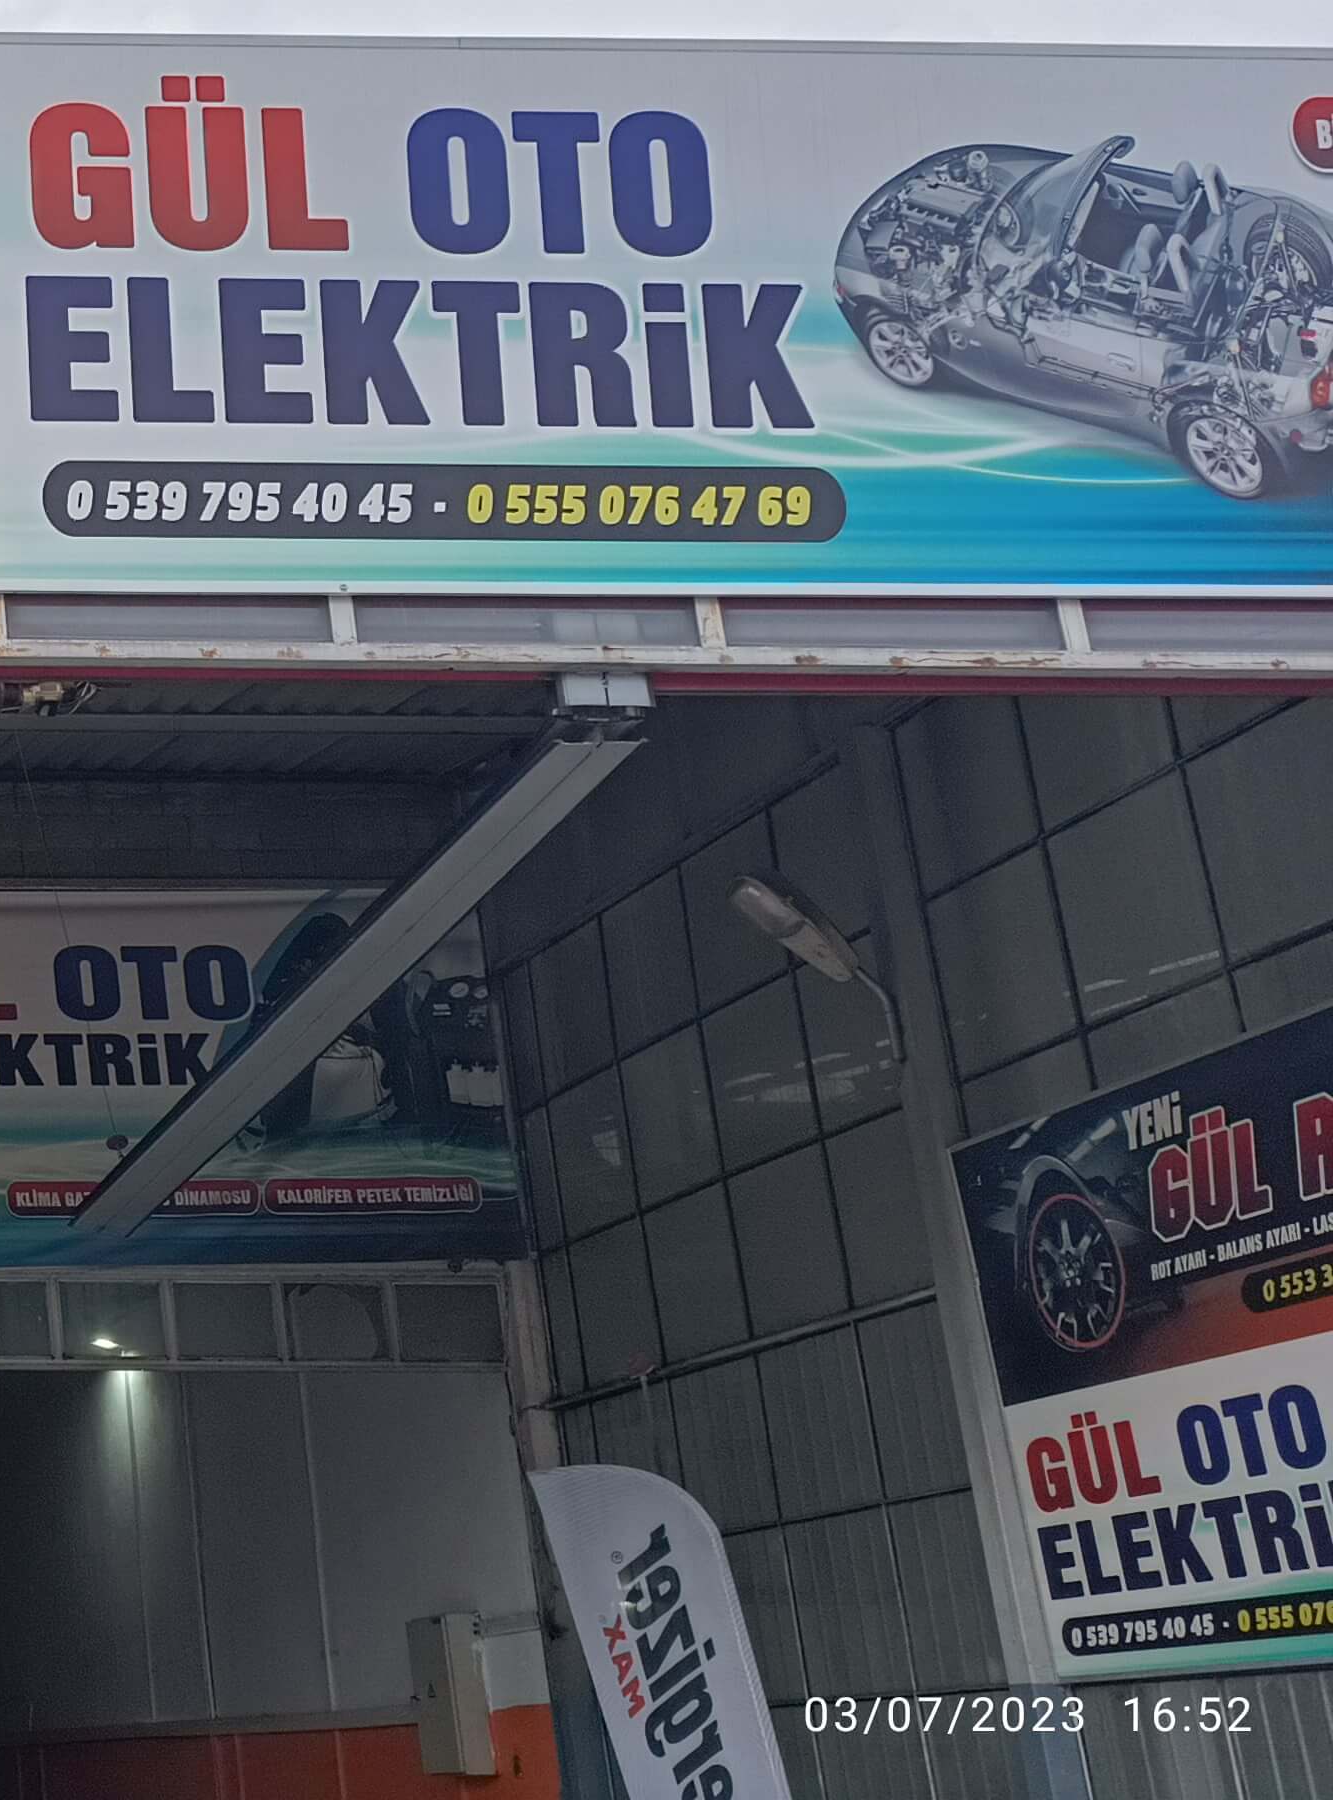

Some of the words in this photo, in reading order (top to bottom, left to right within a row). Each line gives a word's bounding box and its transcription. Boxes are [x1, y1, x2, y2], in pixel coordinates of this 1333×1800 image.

[28, 74, 351, 253] GÜL
[406, 107, 714, 258] OTO
[66, 479, 93, 523] 0
[105, 480, 187, 525] 539
[202, 481, 282, 525] 795
[292, 482, 348, 526] 40
[357, 482, 415, 527] 45
[467, 483, 494, 526] 0
[504, 483, 587, 527] 555
[598, 485, 680, 528] 076
[690, 486, 746, 529] 47
[757, 487, 813, 529] 69
[53, 945, 250, 1022] OTO
[15, 1187, 62, 1208] KLİMA
[175, 1187, 251, 1207] DİNAMOSU
[276, 1185, 353, 1205] KALORİFER
[356, 1188, 403, 1204] PETEK
[1147, 1105, 1273, 1243] GÜL
[1151, 1259, 1172, 1281] ROT
[1174, 1248, 1207, 1274] AYARI
[1217, 1235, 1264, 1262] BALANS
[1265, 1222, 1301, 1248] AYARI
[1262, 1279, 1275, 1303] 0
[1279, 1269, 1317, 1297] 553
[1026, 1411, 1162, 1513] GÜL
[1177, 1384, 1327, 1486] OTO
[1070, 1627, 1083, 1649] 0
[1086, 1623, 1119, 1647] 539
[1123, 1619, 1157, 1644] 795
[1162, 1616, 1187, 1640] 40
[1190, 1612, 1215, 1637] 45
[1237, 1608, 1251, 1633] 0
[1254, 1604, 1294, 1631] 555
